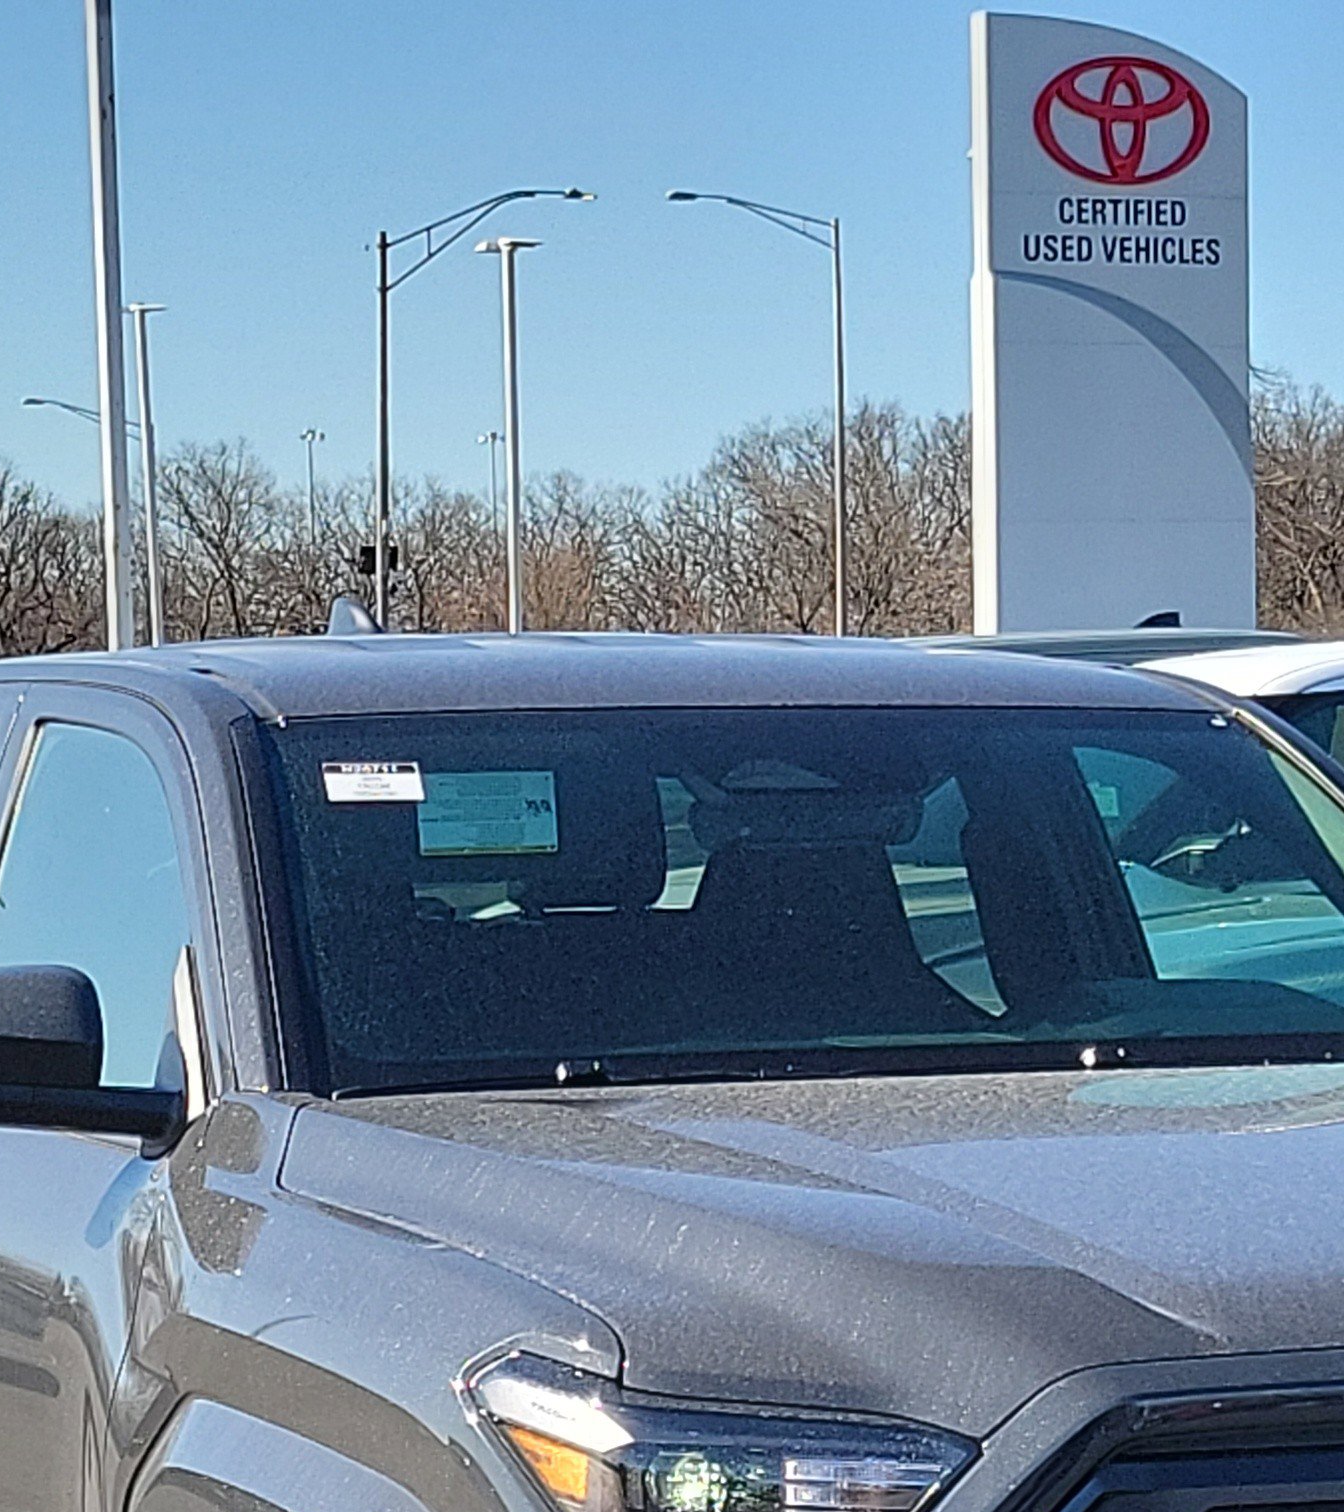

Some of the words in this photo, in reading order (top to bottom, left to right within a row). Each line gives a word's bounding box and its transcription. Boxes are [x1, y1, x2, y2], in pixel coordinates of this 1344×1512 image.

[1059, 197, 1187, 226] CERTIFIED
[1023, 234, 1093, 262] USED
[1102, 236, 1221, 265] VEHICLES
